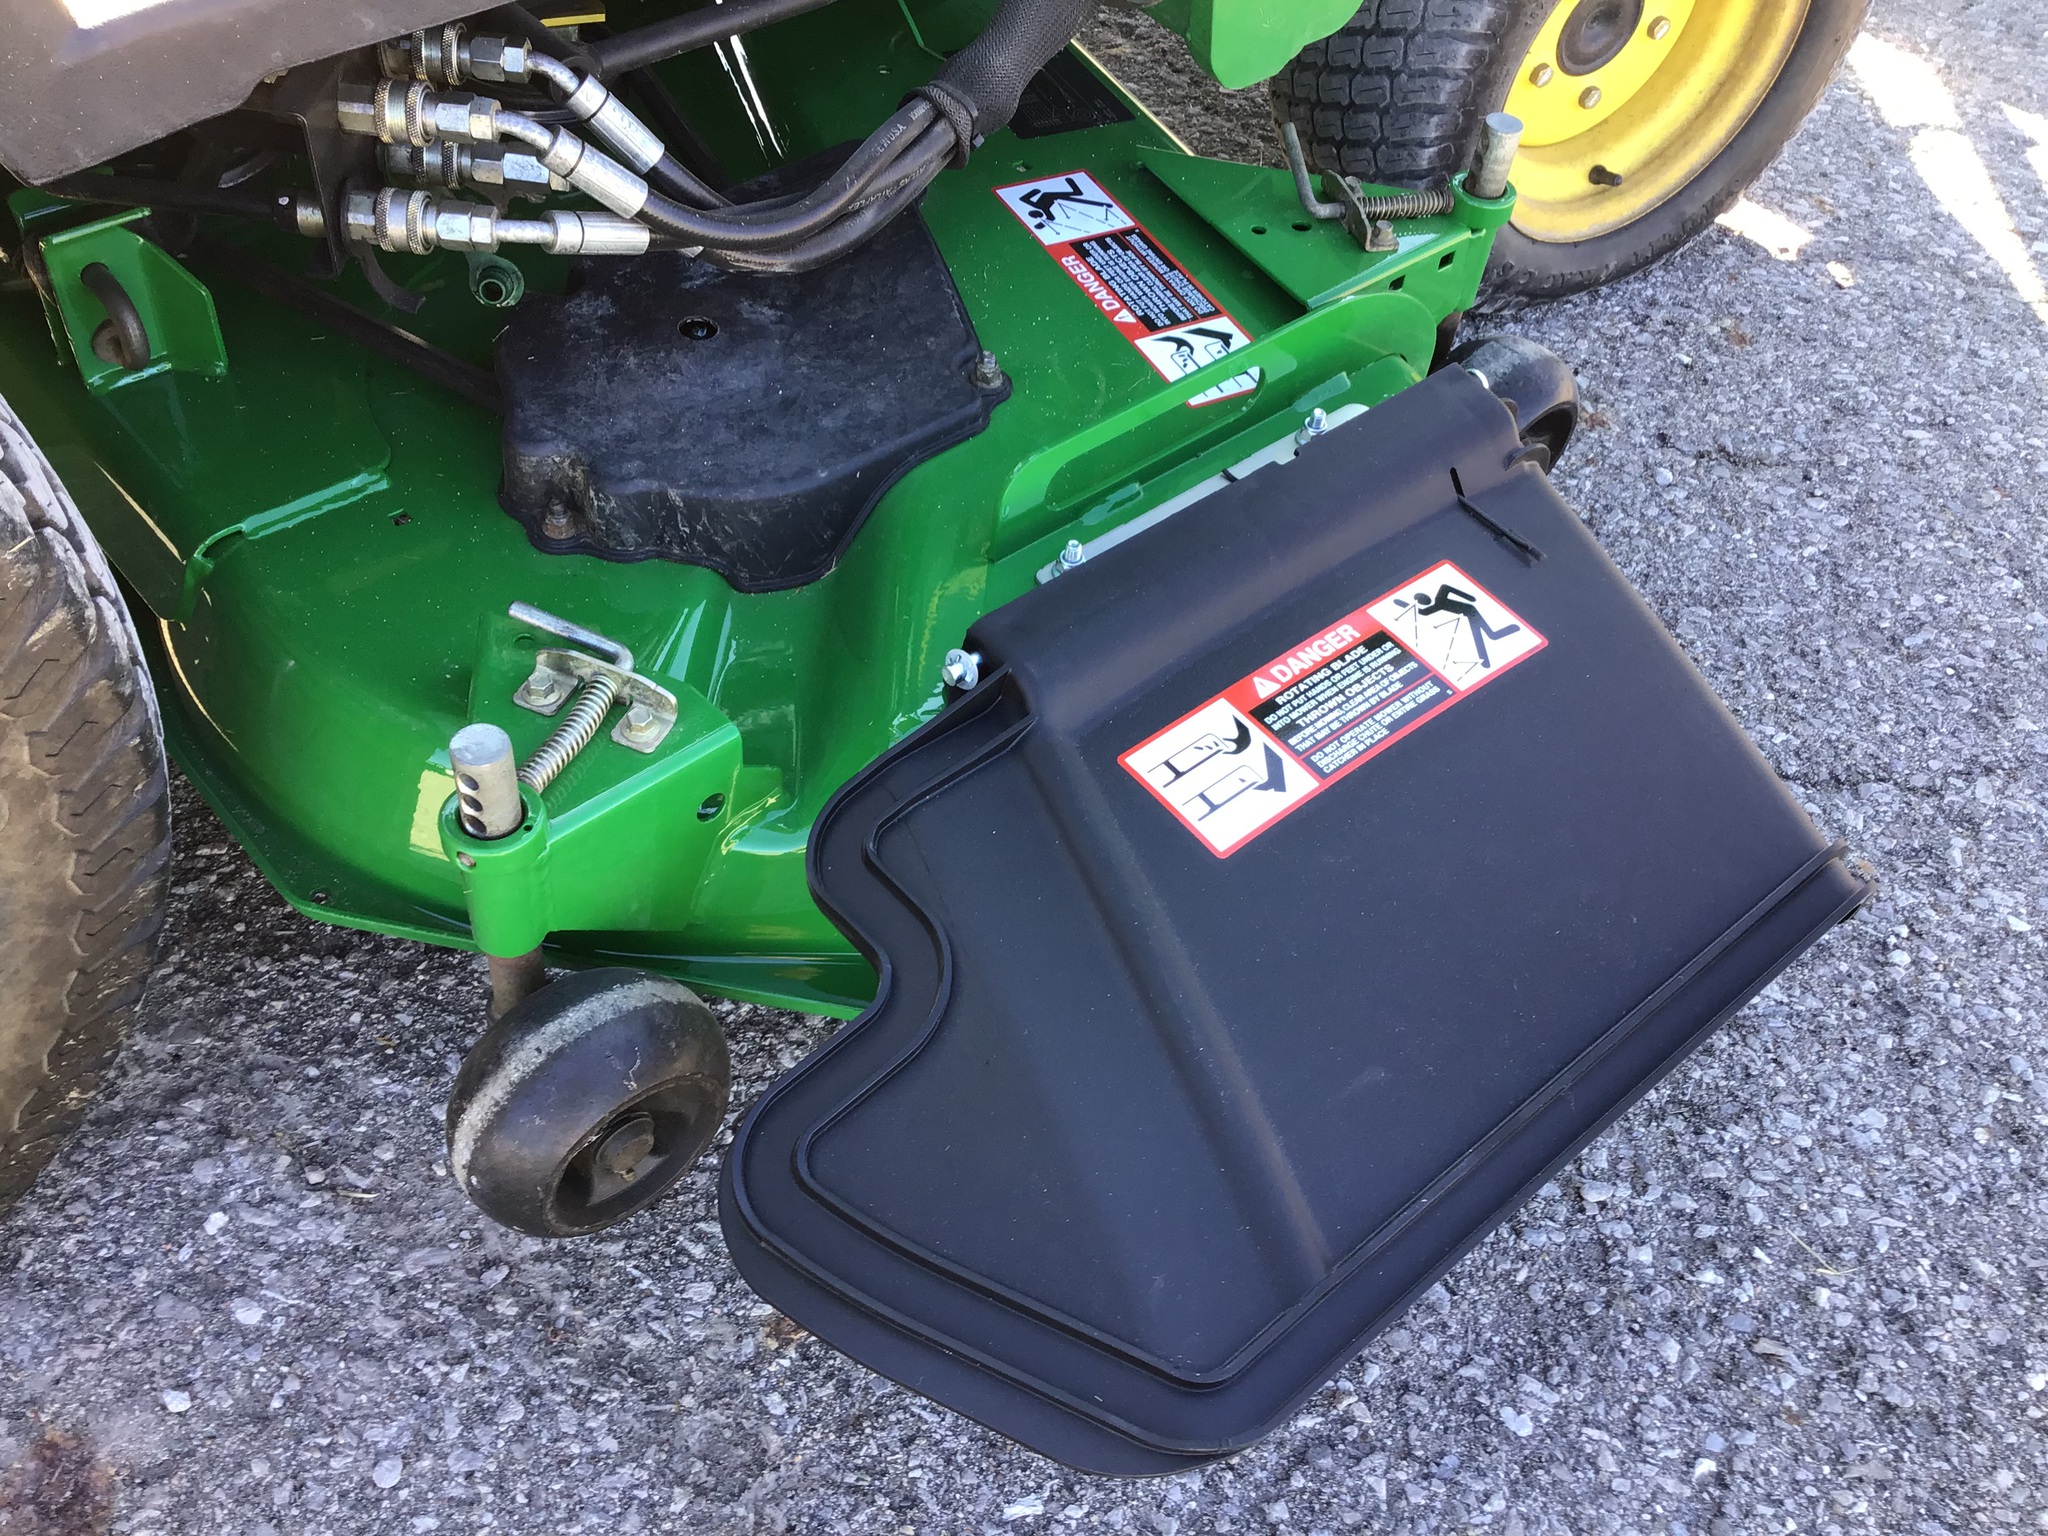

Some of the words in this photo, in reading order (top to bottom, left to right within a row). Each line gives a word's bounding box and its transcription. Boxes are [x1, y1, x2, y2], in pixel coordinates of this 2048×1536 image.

[1062, 256, 1120, 310] DANGER
[1086, 256, 1110, 280] BLADE
[1107, 249, 1139, 280] OBJECTS
[1108, 280, 1144, 316] ROTATING
[1137, 281, 1168, 312] THROWN
[1264, 714, 1278, 724] DO
[1276, 704, 1292, 717] NOT
[1291, 694, 1307, 707] PUT
[1306, 680, 1332, 698] HANDS
[1330, 673, 1343, 682] OR
[1341, 662, 1360, 676] FEET
[1358, 648, 1383, 665] UNDER
[1382, 642, 1394, 651] OR
[1270, 624, 1360, 682] DANGER
[1275, 668, 1332, 705] ROTATING
[1330, 645, 1368, 671] BLADE
[1271, 717, 1291, 730] INTO
[1289, 699, 1318, 719] MOWER
[1316, 686, 1339, 702] WHEN
[1337, 670, 1364, 689] ENGINE
[1369, 648, 1401, 669] RUNNING
[1288, 725, 1317, 745] BEFORE
[1342, 694, 1365, 710] CLEAR
[1363, 684, 1382, 698] AREA
[1380, 678, 1389, 687] OF
[1389, 662, 1418, 681] OBJECTS
[1295, 736, 1316, 751] THAT
[1314, 727, 1330, 740] MAY
[1329, 720, 1342, 730] BE
[1339, 701, 1371, 723] THROWN
[1368, 695, 1380, 705] BY
[1378, 681, 1403, 698] BLADE
[1296, 694, 1346, 726] THROWN
[1345, 664, 1394, 696] OBJECTS
[1311, 752, 1324, 762] DO
[1323, 740, 1340, 754] NOT
[1340, 718, 1375, 743] OPERATE
[1374, 701, 1402, 721] MOWER
[1400, 681, 1433, 703] WITHOUT
[1317, 738, 1359, 768] DISCHARGE
[1357, 723, 1383, 741] CHUTE
[1381, 716, 1393, 726] OR
[1391, 700, 1418, 719] ENTIRE
[1416, 686, 1440, 703] GRASS
[1323, 748, 1358, 773] CATCHER
[1356, 743, 1366, 751] IN
[1364, 728, 1389, 746] PLACE
